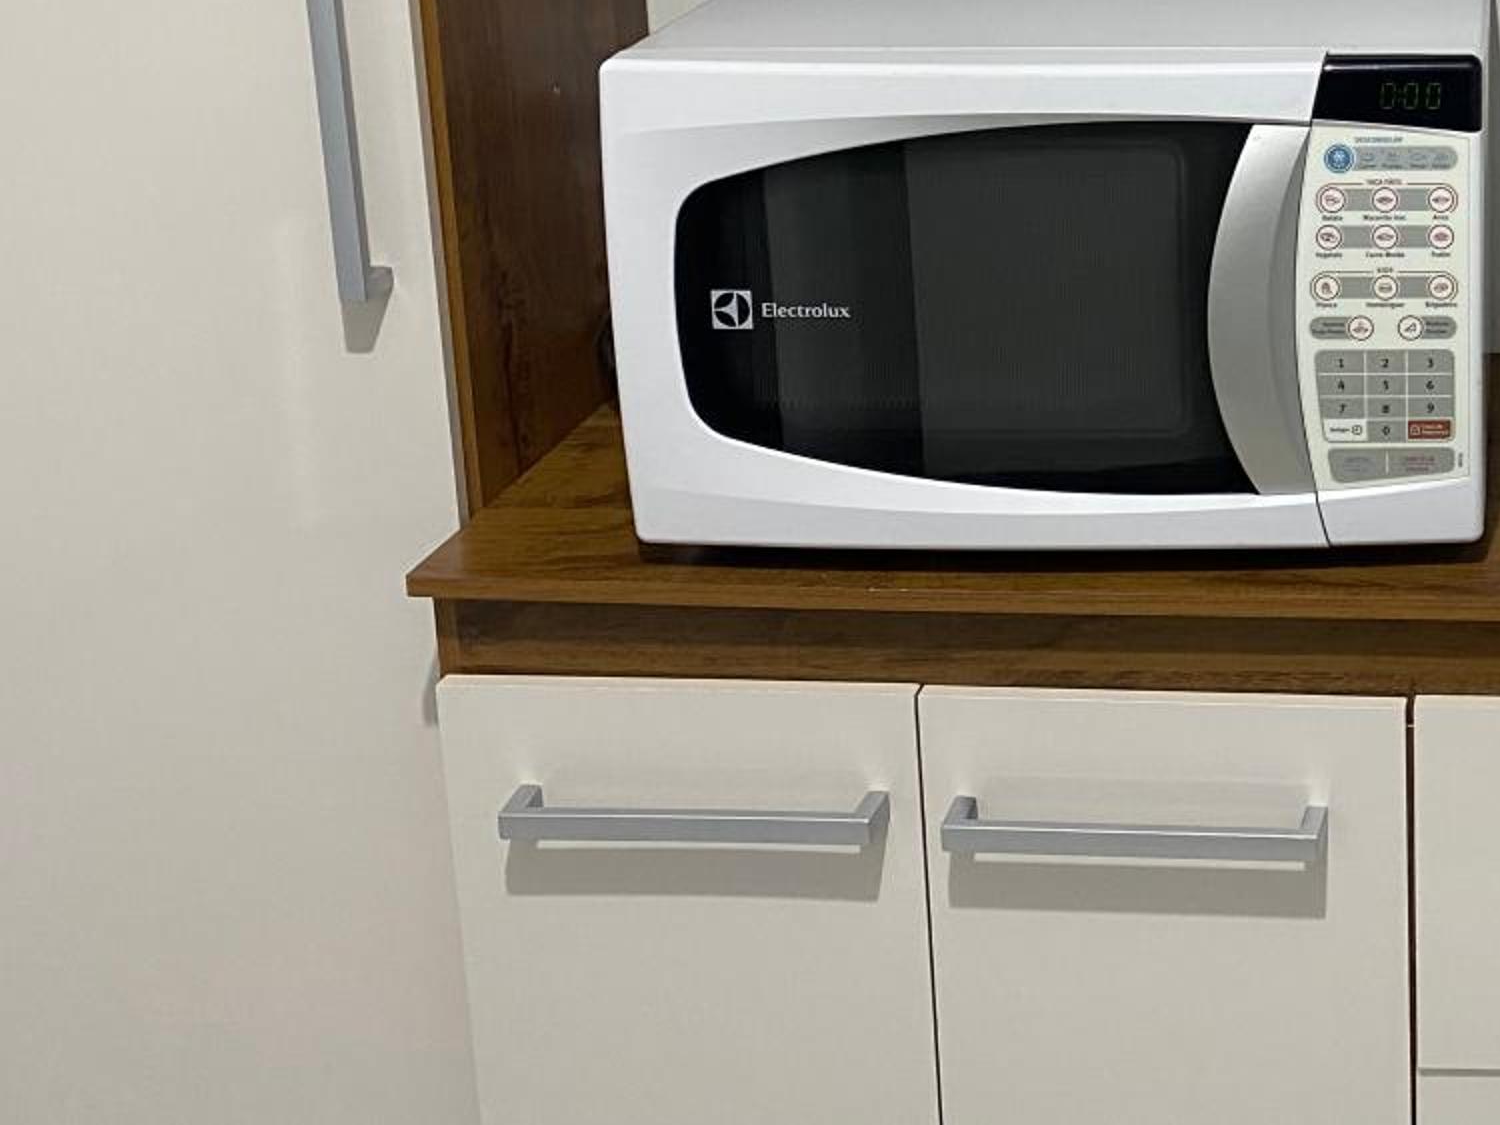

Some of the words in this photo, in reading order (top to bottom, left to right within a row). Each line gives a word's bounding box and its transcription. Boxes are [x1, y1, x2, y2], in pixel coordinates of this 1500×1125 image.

[761, 302, 851, 318] Electrolux
[1338, 358, 1344, 368] 1
[1381, 358, 1389, 368] 2
[1428, 358, 1434, 368] 3
[1338, 380, 1345, 390] 4
[1382, 380, 1389, 390] 5
[1426, 380, 1434, 390] 6
[1339, 403, 1346, 413] 7
[1382, 404, 1390, 413] 8
[1427, 403, 1434, 413] 9
[1382, 425, 1390, 435] 0
